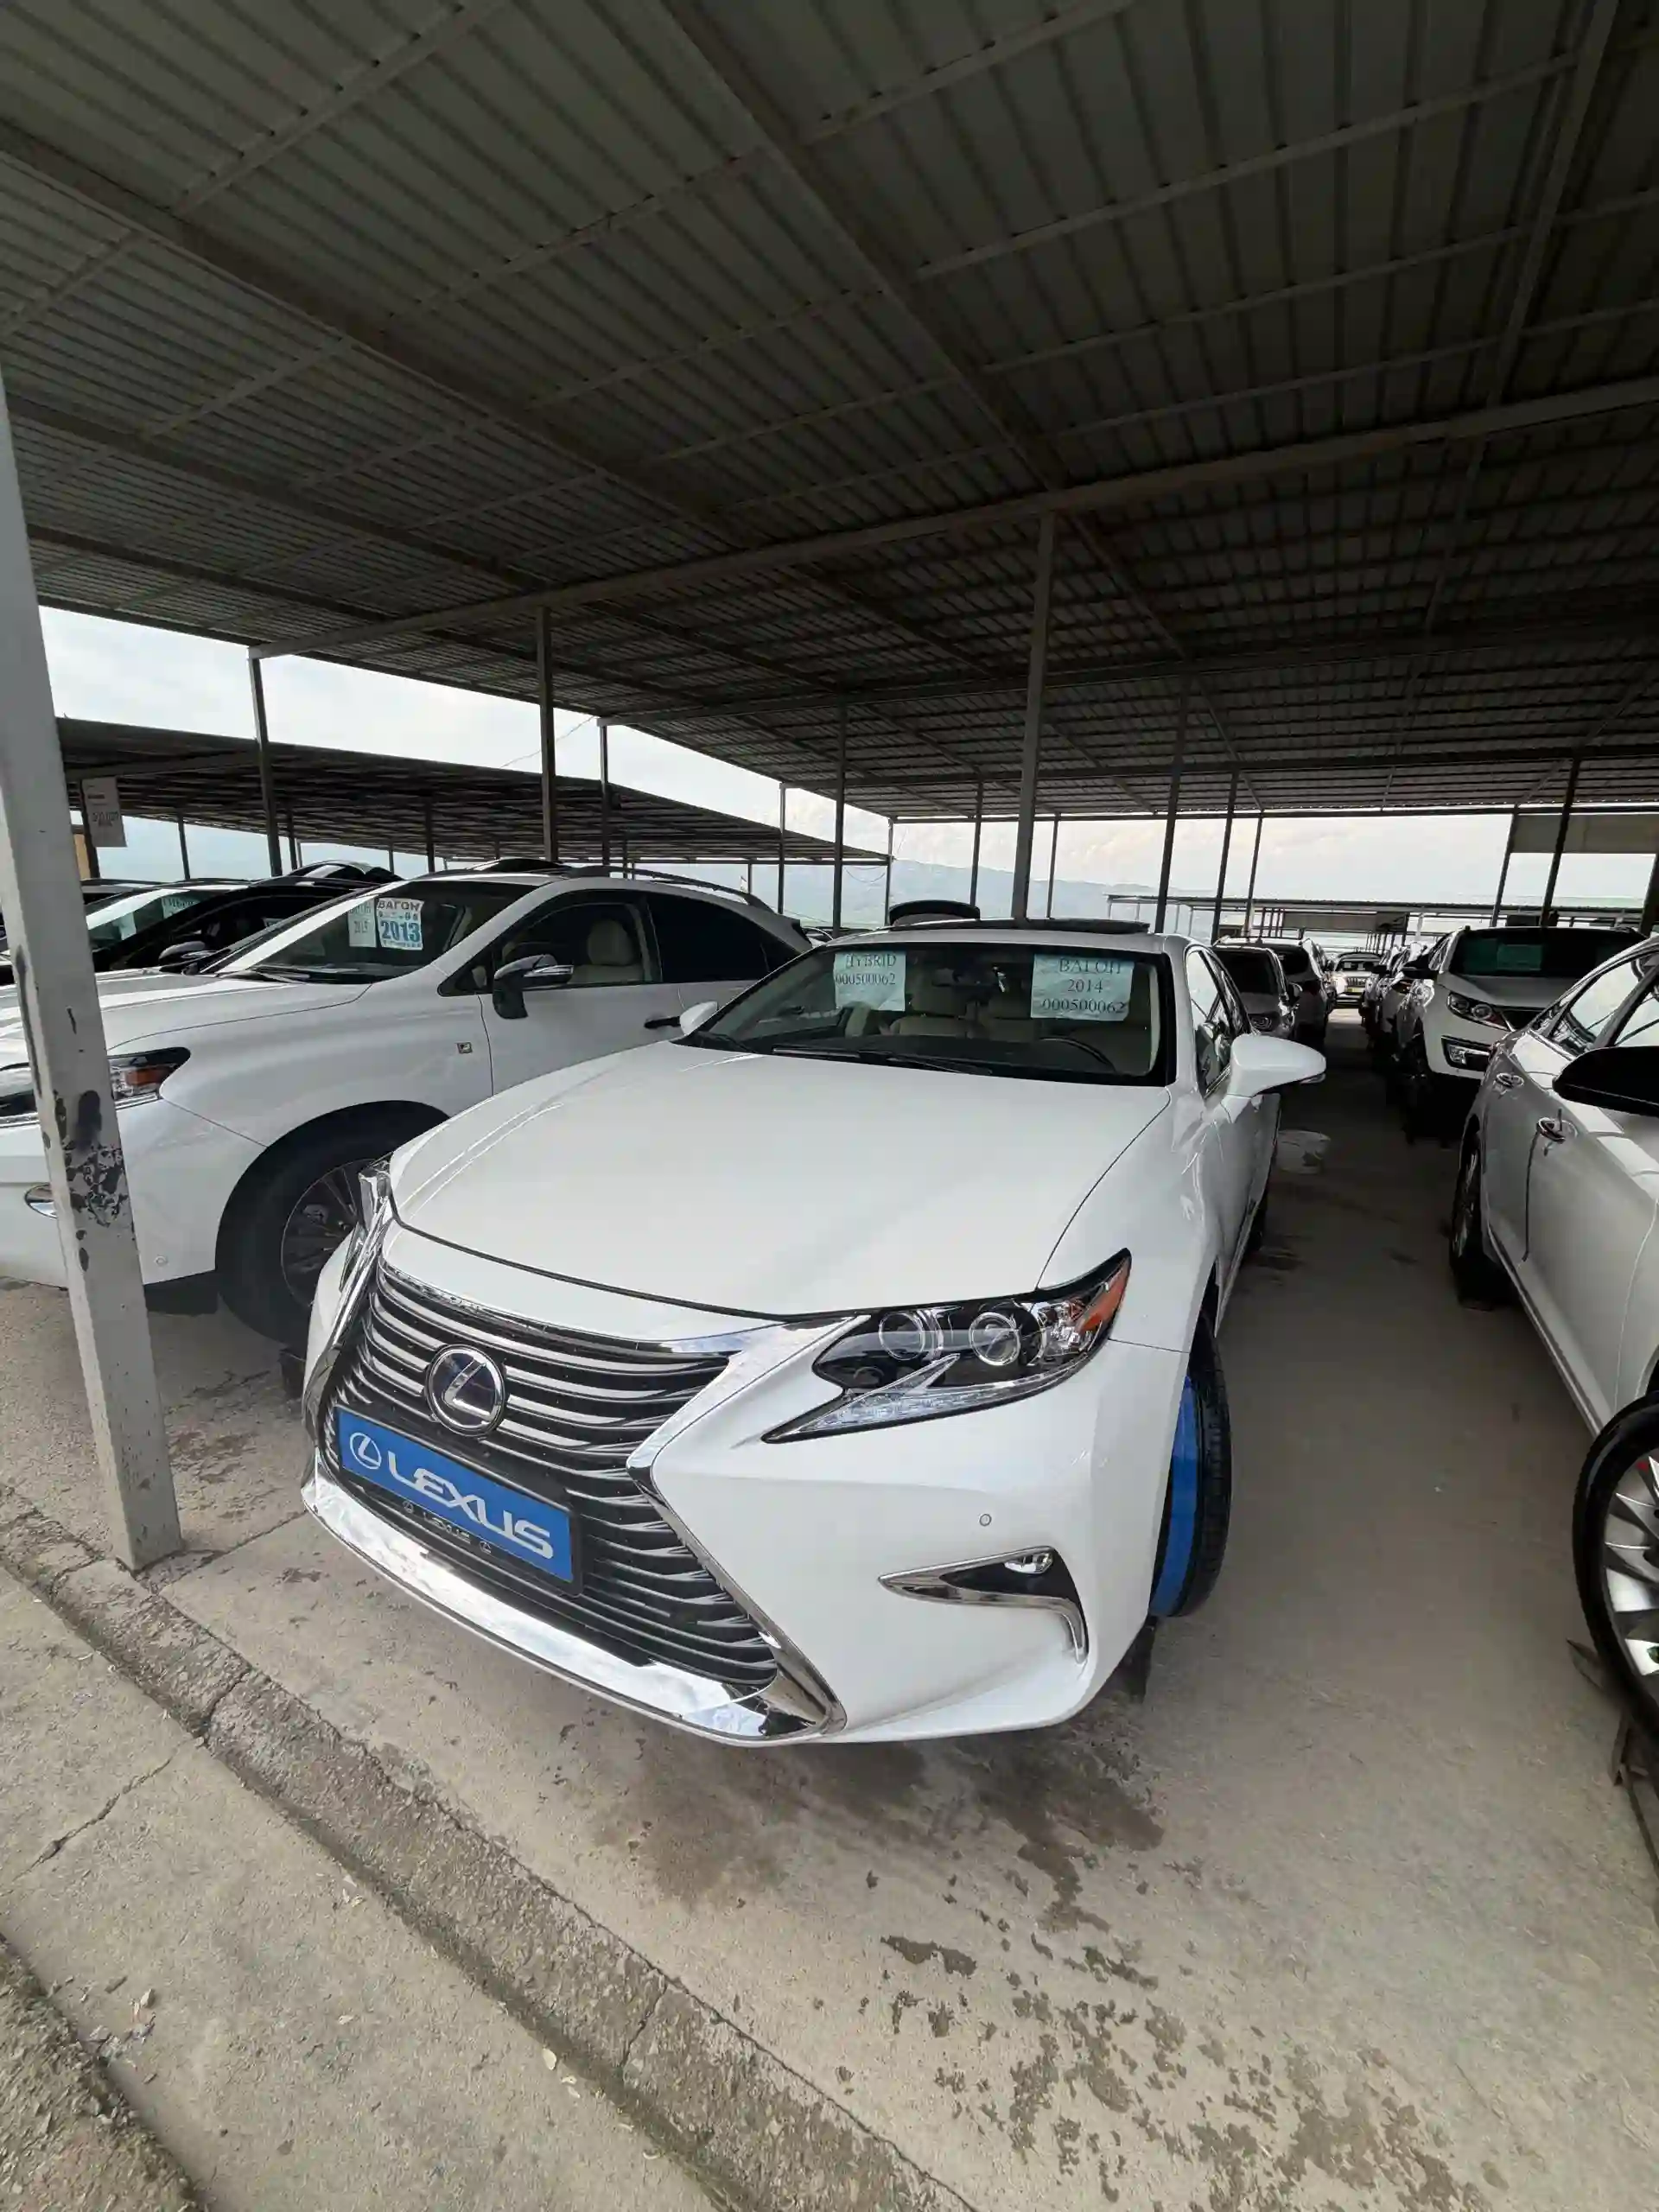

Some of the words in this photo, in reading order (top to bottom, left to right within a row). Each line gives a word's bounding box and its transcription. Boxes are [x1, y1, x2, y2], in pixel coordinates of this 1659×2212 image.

[381, 920, 421, 943] 2013
[1068, 978, 1103, 993] 2014
[1042, 998, 1126, 1014] 000500062
[388, 1451, 554, 1559] LEXUS
